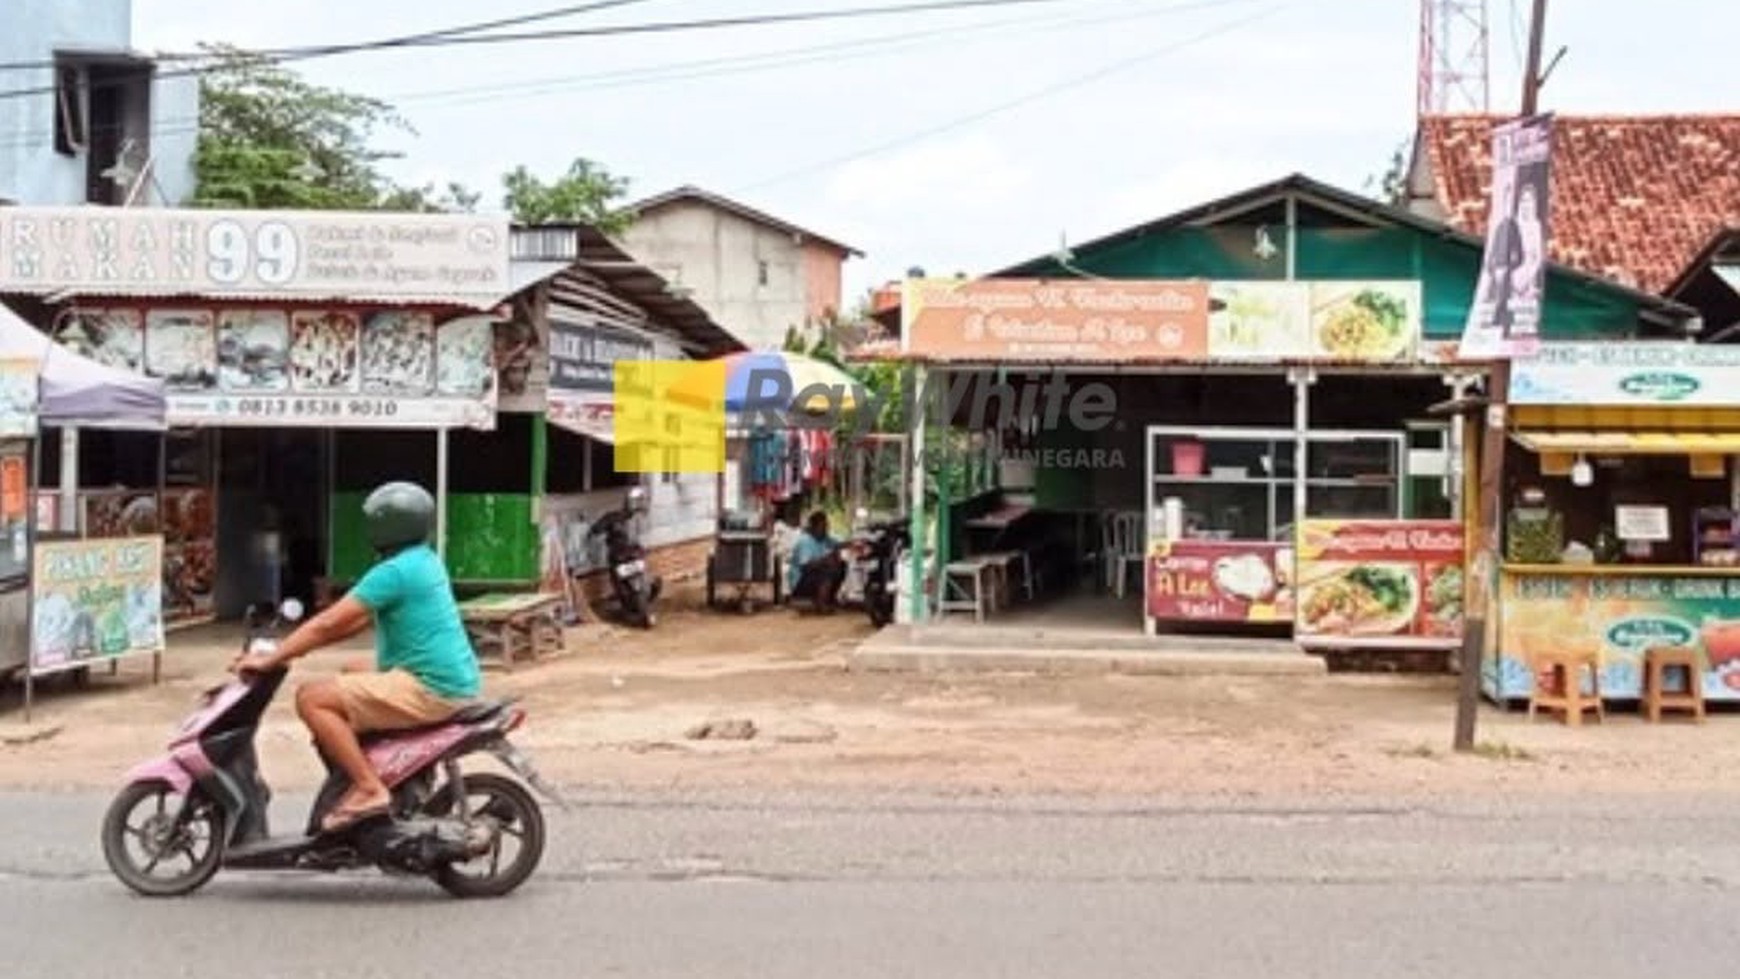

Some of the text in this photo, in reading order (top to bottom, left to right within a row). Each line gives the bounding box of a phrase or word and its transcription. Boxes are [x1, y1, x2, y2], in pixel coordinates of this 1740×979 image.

[11, 216, 197, 248] RUMAH
[11, 249, 197, 281] MAKAN
[205, 216, 299, 286] 99
